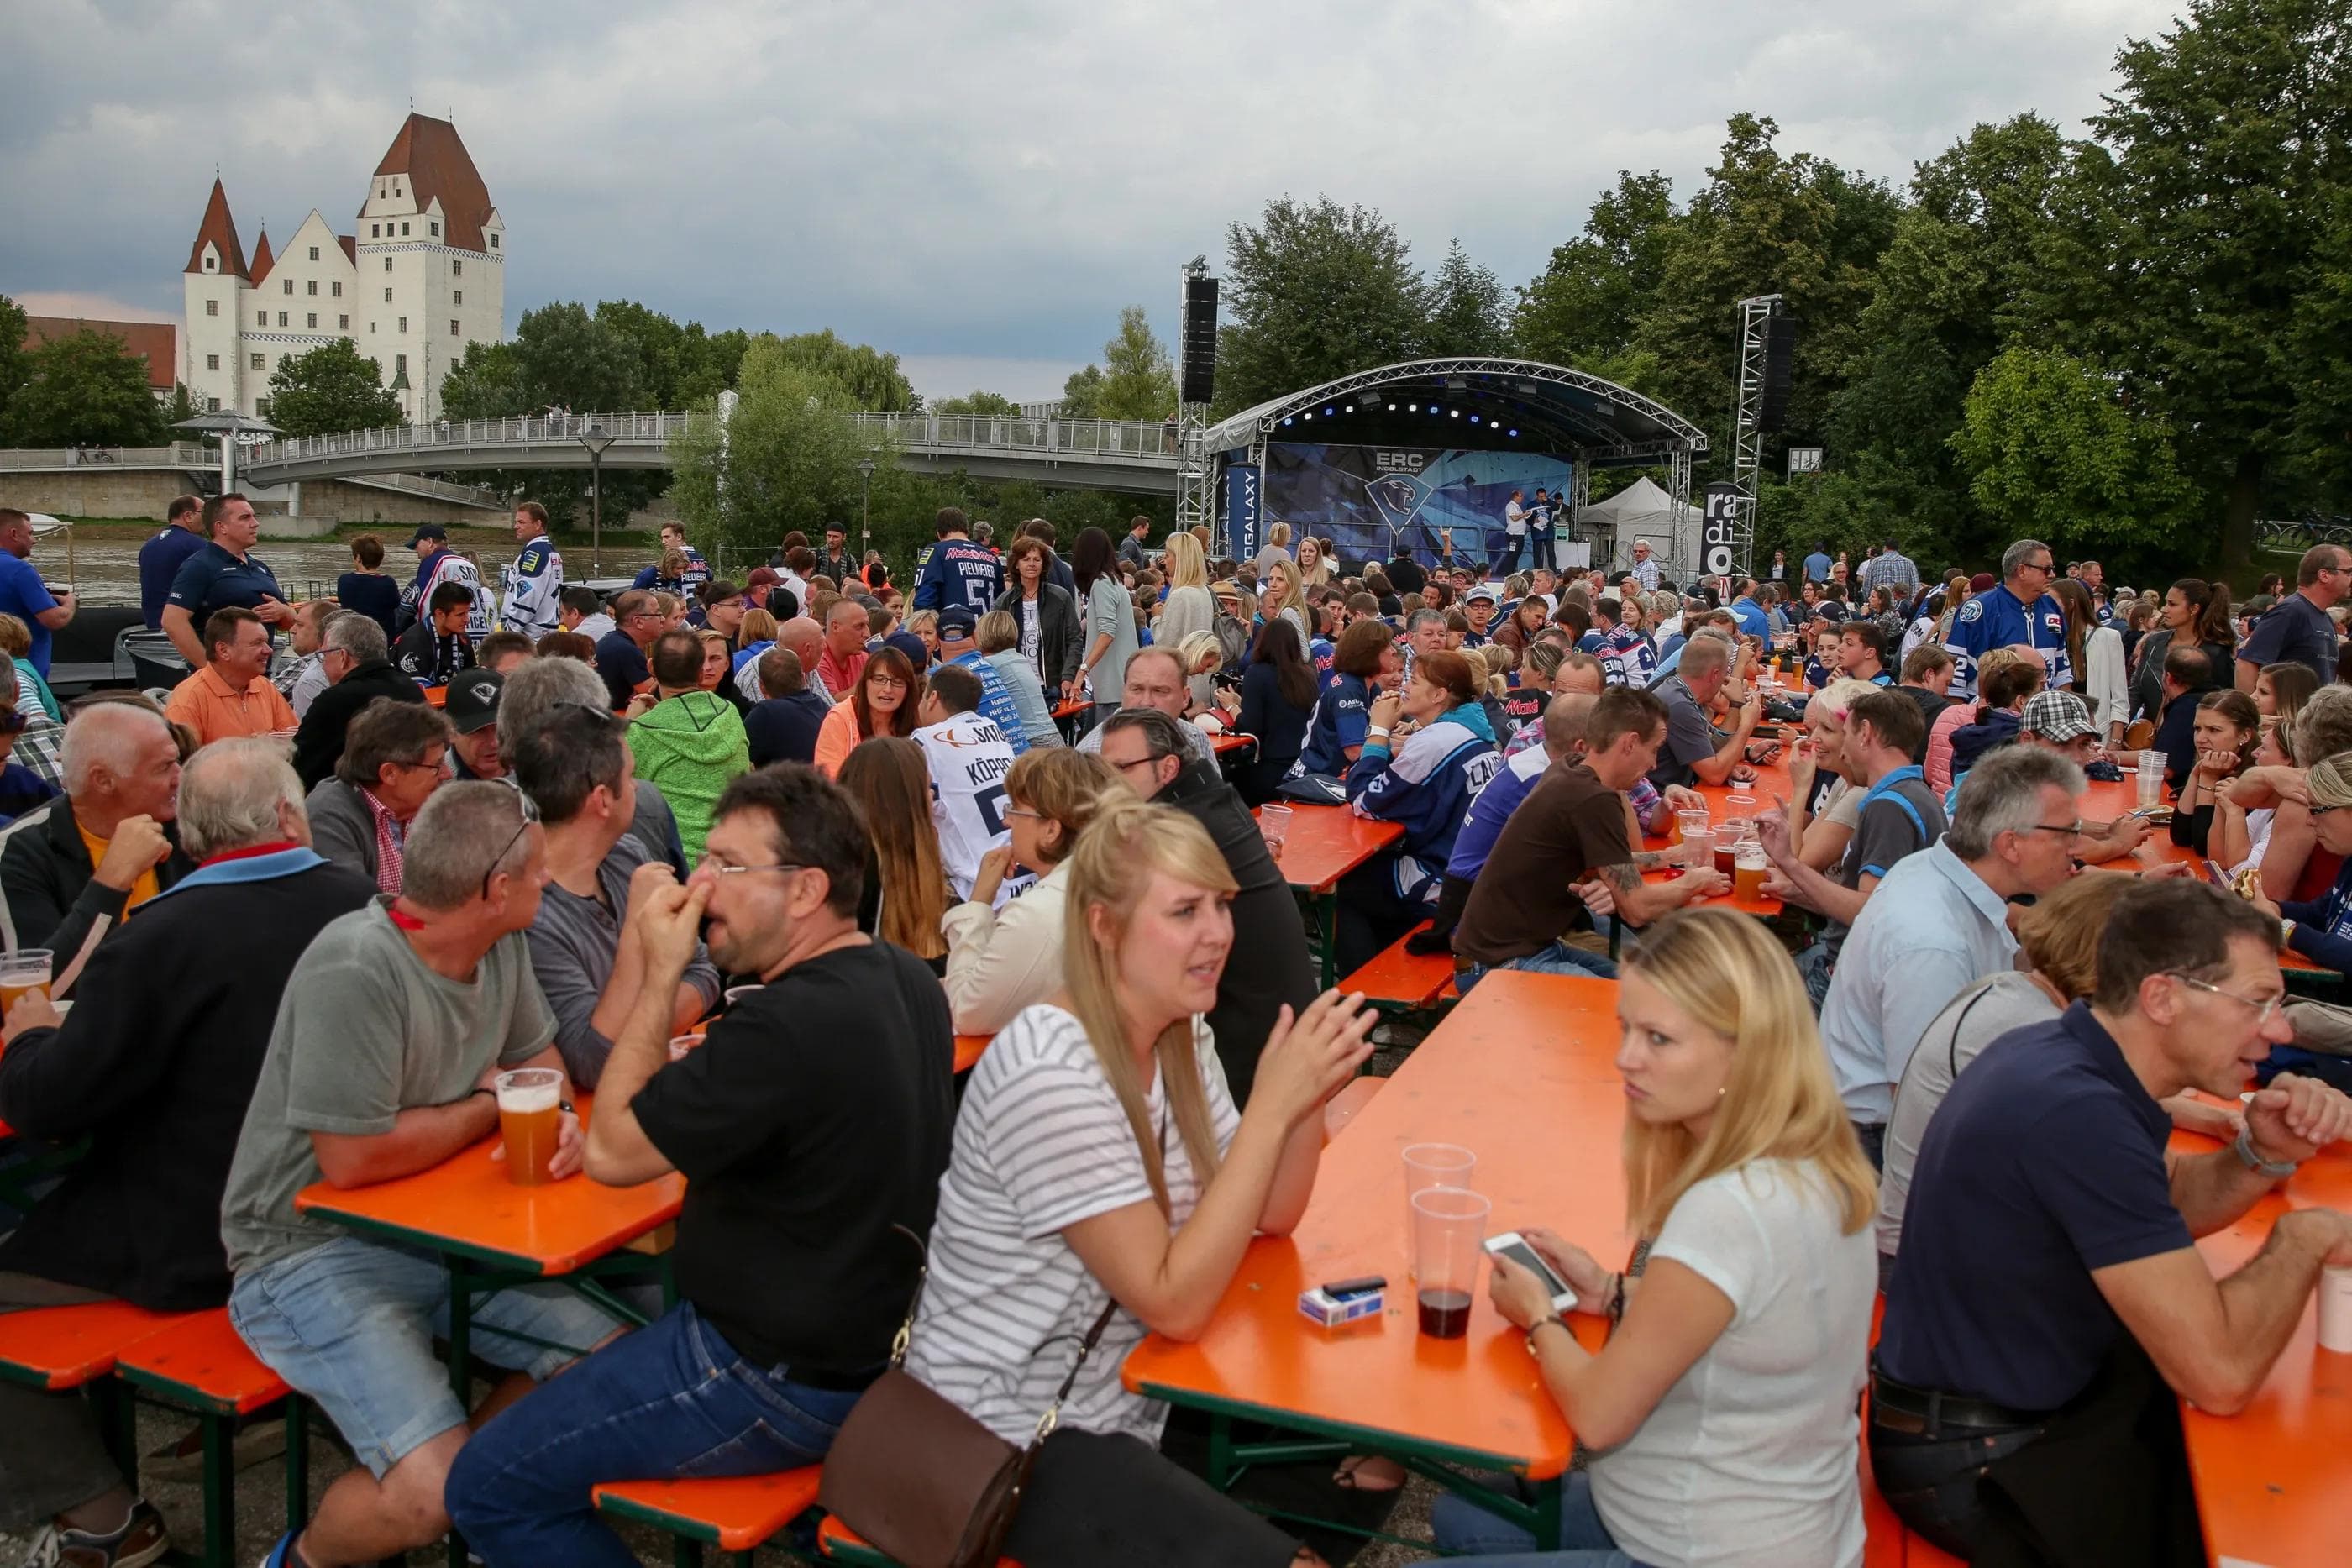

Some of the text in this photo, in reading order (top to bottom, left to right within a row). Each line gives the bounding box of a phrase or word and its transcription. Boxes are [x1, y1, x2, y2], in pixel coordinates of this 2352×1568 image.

[1376, 453, 1423, 467] ERC
[1707, 493, 1736, 517] ra
[1244, 471, 1255, 563] OGALAXY
[1706, 520, 1735, 544] di
[459, 565, 478, 582] SAT
[958, 561, 995, 579] PIELMEIER
